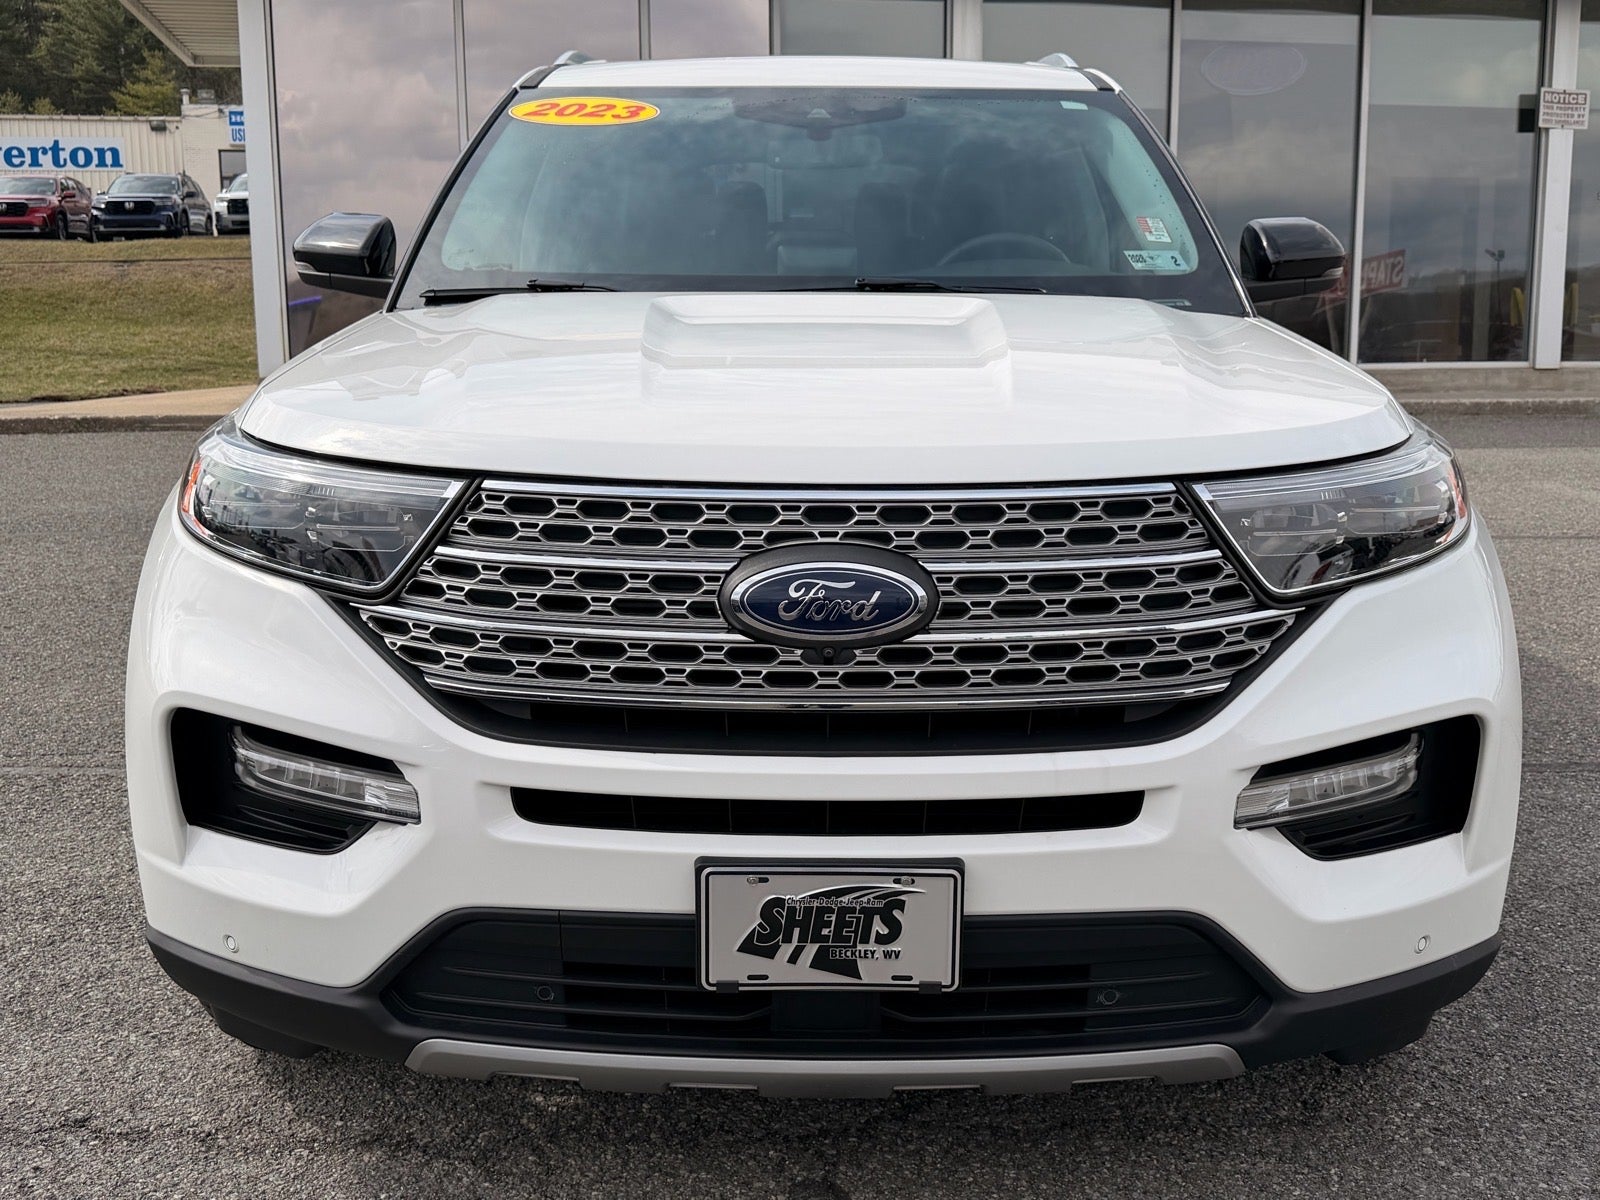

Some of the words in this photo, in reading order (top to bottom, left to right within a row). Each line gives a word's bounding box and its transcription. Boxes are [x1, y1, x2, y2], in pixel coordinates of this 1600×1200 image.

[1544, 92, 1586, 103] NOTICE
[523, 102, 646, 119] 2023
[231, 128, 246, 143] US
[0, 139, 124, 169] erton
[777, 578, 882, 621] Ford
[754, 896, 906, 946] SHEETS
[829, 949, 880, 960] BECKLEY,
[882, 949, 902, 960] WV
